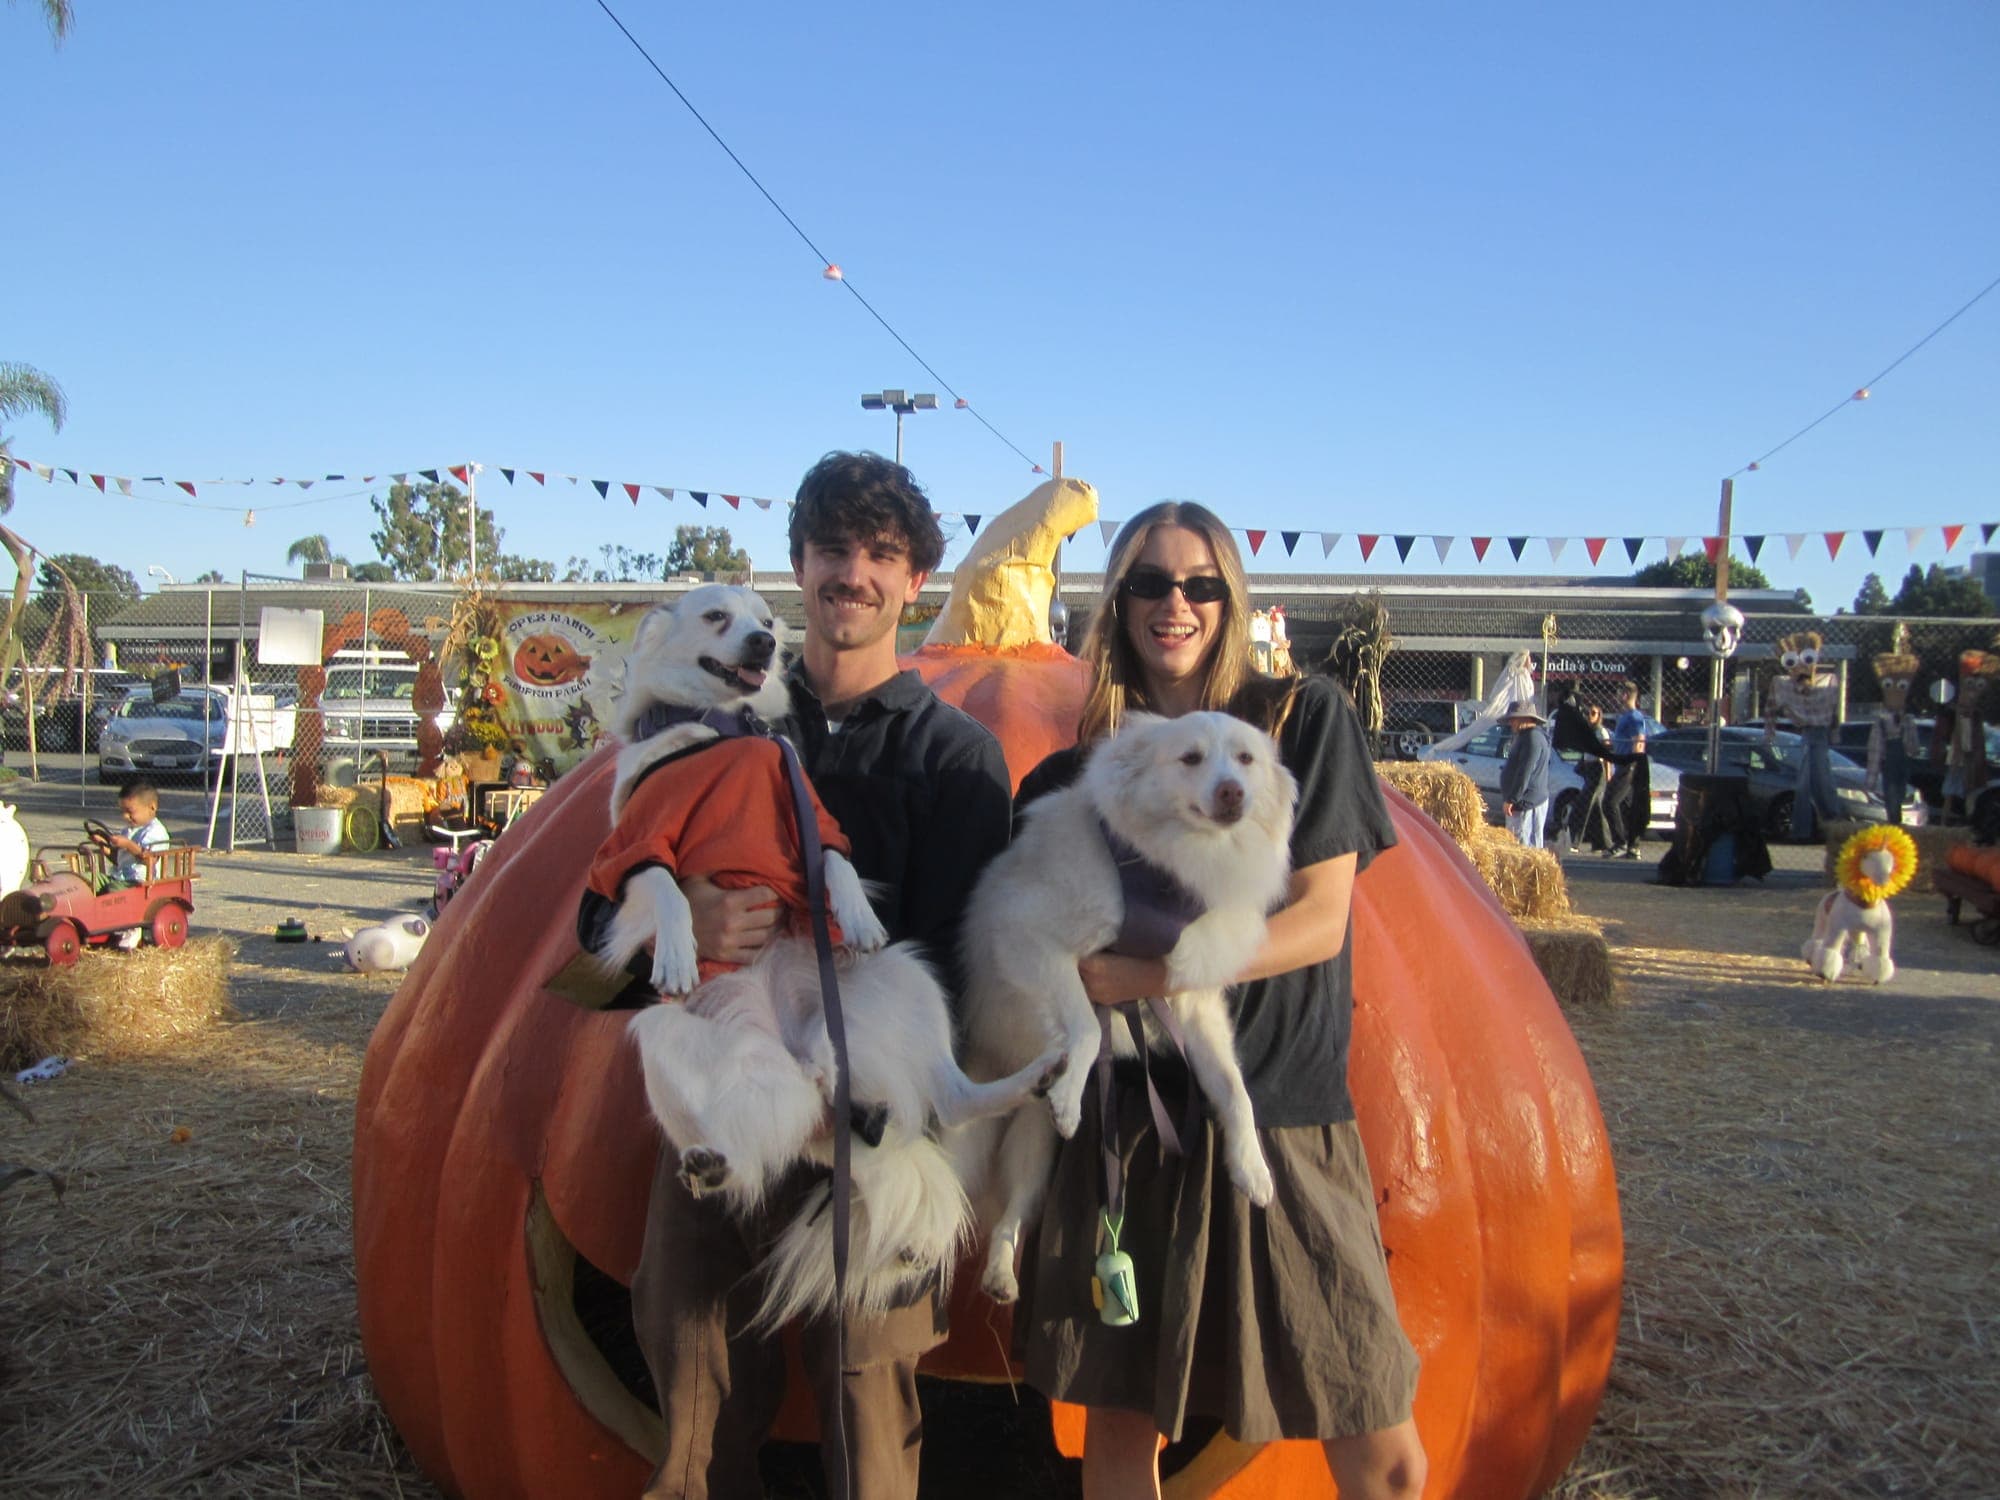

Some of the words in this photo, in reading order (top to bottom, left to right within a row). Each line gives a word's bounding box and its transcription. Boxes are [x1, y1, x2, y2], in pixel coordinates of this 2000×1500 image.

[550, 613, 595, 639] RANCH
[1591, 659, 1625, 672] Oven
[503, 674, 553, 698] PUMPKIN
